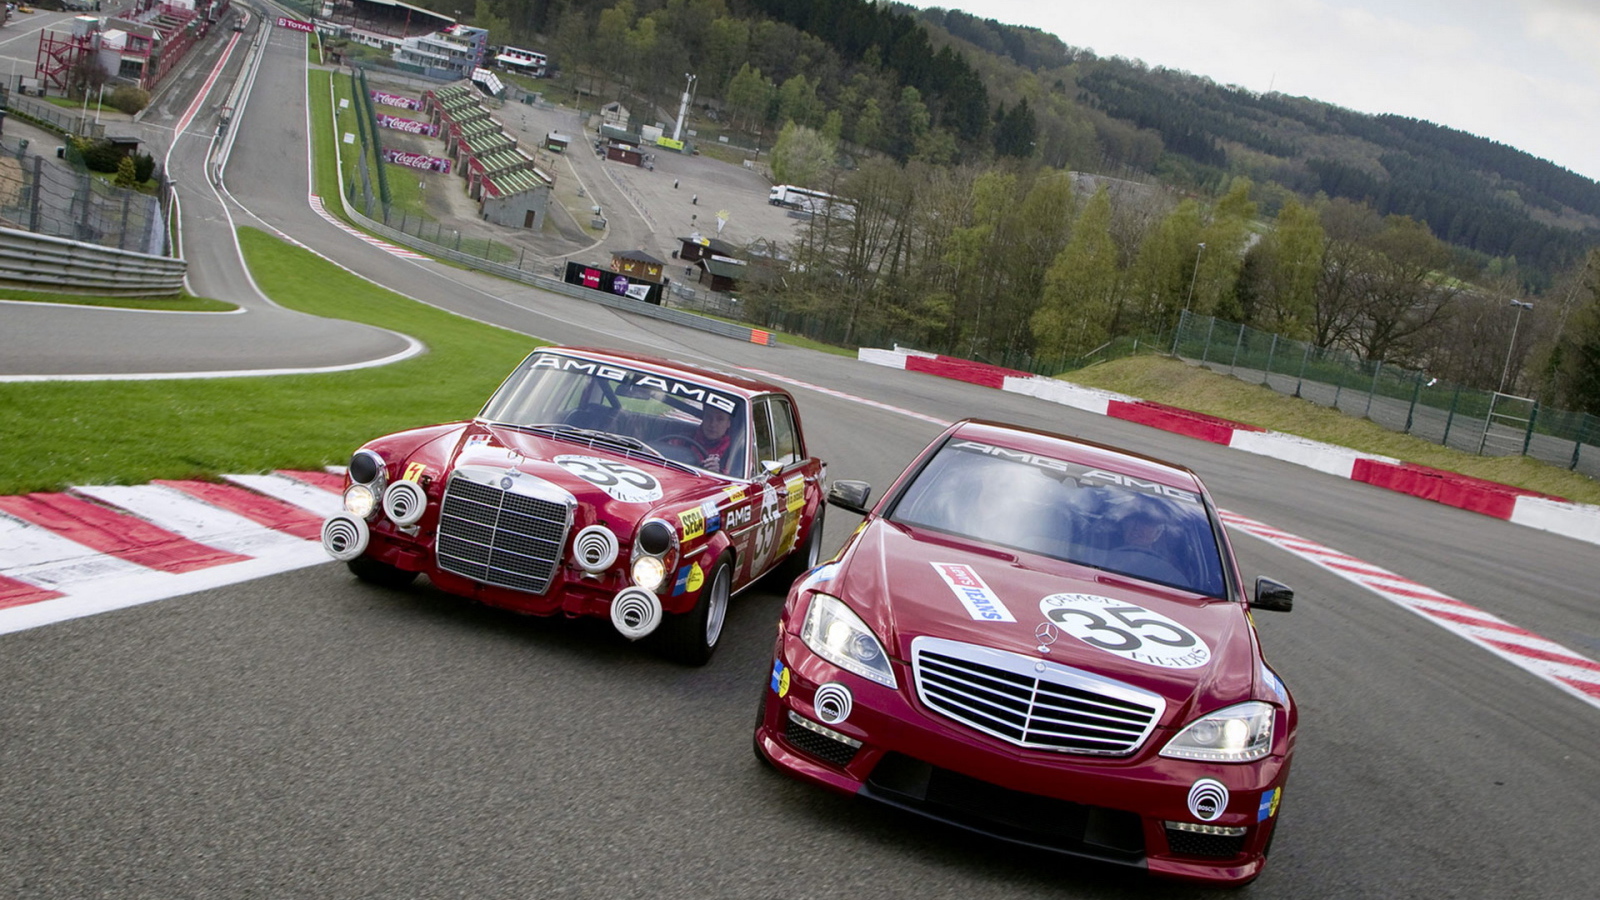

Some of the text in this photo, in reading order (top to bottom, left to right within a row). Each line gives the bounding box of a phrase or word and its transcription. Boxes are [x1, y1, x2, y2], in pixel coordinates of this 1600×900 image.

[287, 20, 312, 31] TOTAL
[530, 357, 736, 414] AMG AMG
[557, 460, 657, 490] 35
[951, 441, 1198, 504] AMG AMG
[725, 504, 751, 530] AMG
[962, 587, 1003, 620] JEANS
[1047, 606, 1196, 651] 35
[1131, 648, 1208, 666] FILTERS
[822, 706, 838, 717] BOSCH
[1198, 804, 1215, 812] BOSCH
